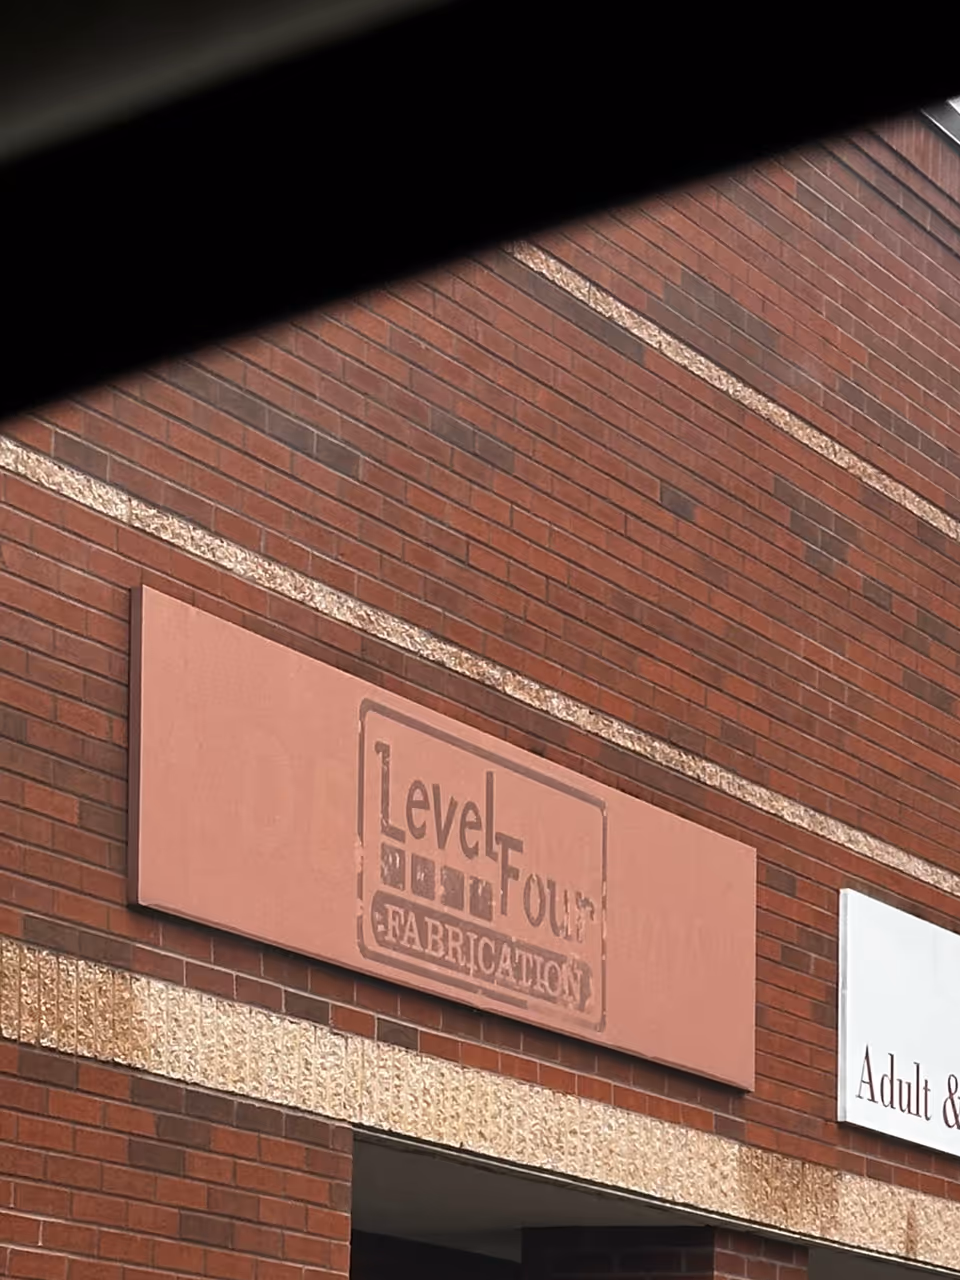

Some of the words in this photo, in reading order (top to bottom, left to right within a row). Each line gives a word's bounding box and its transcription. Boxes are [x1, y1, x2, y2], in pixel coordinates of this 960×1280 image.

[374, 740, 498, 862] Level
[384, 902, 584, 1006] FABRICATION
[854, 1043, 932, 1122] Adult
